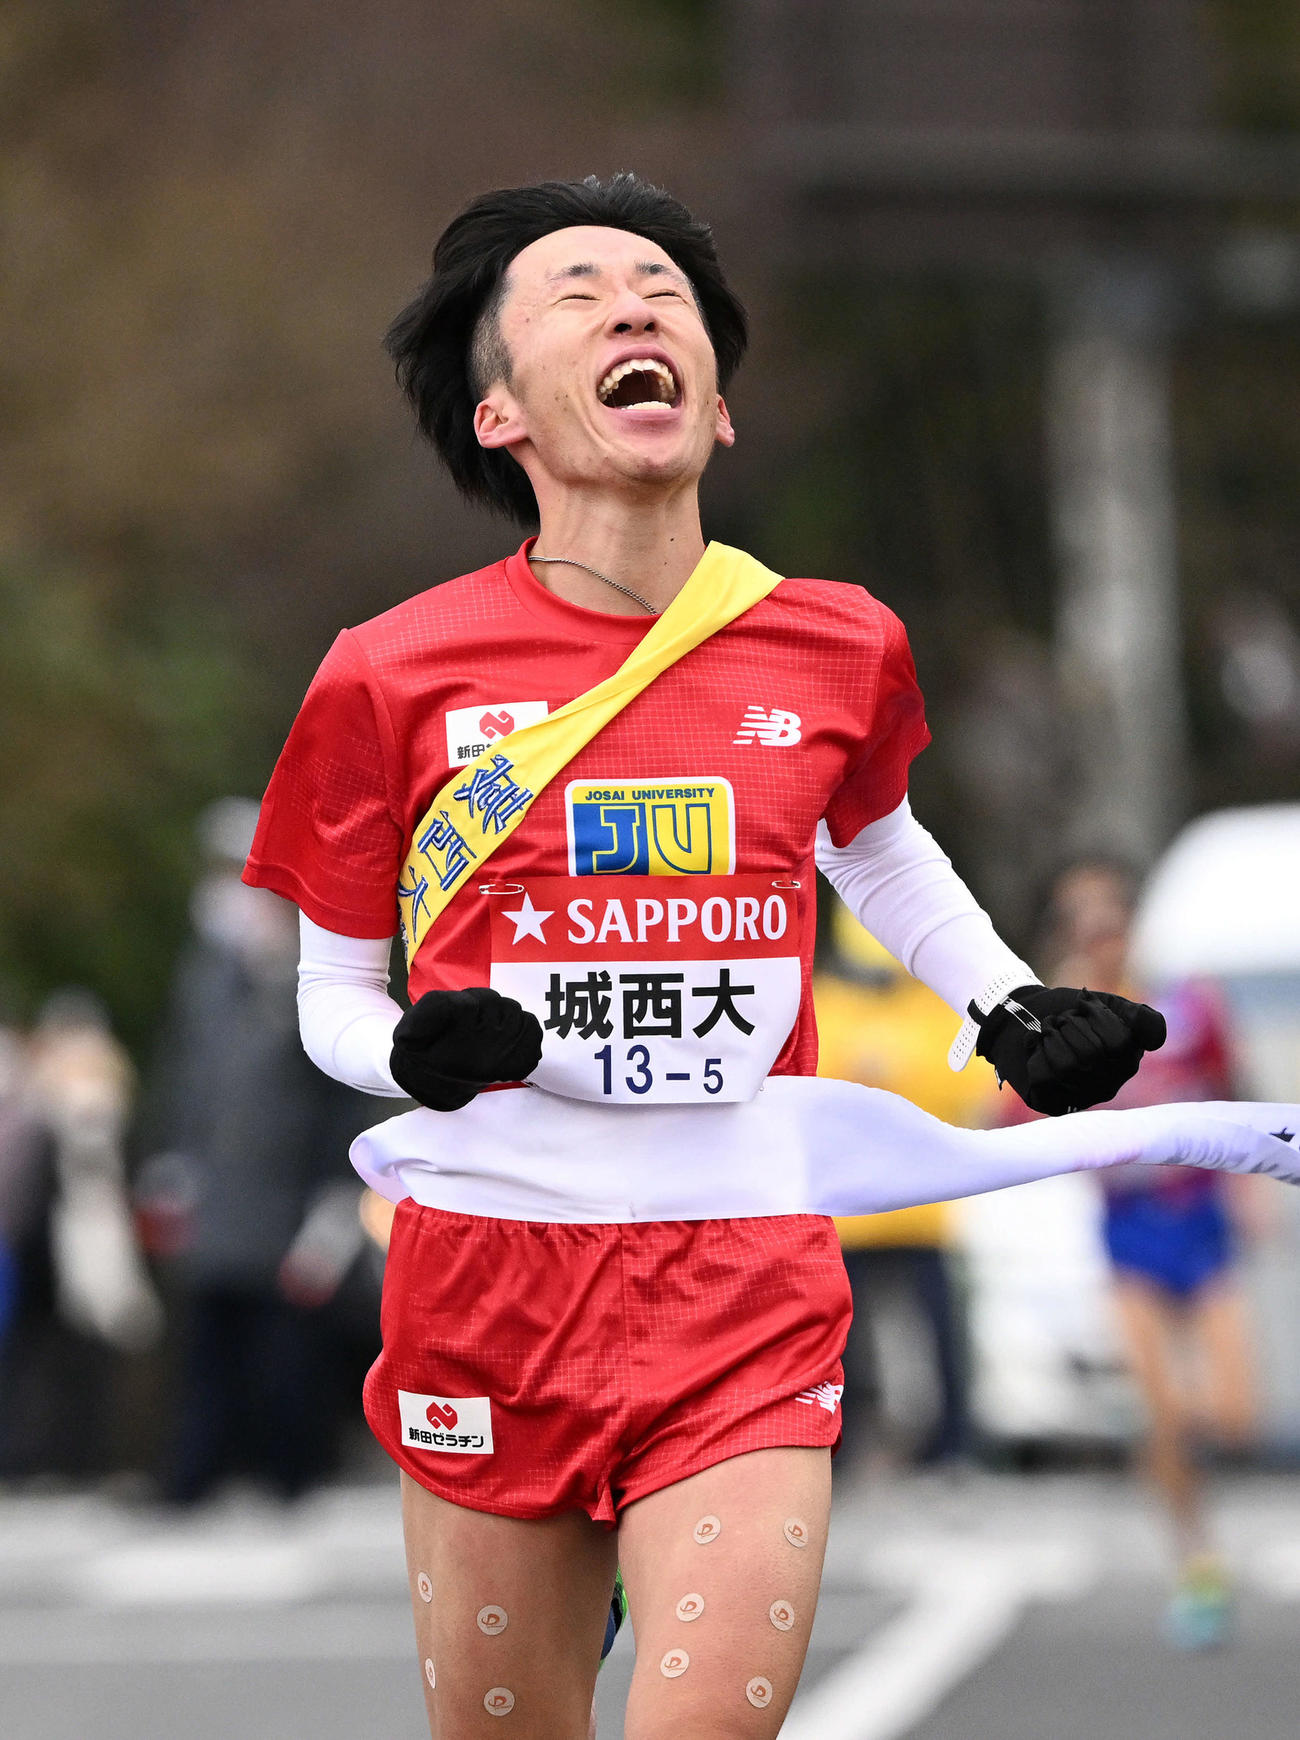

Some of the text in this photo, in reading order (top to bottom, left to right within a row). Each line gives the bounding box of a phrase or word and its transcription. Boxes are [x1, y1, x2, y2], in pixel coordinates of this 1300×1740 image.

[457, 743, 492, 759] 新田
[585, 787, 715, 801] JOSAI UNIVERSITY
[592, 803, 712, 875] JU
[567, 894, 787, 945] SAPPORO
[544, 968, 756, 1041] 城西大
[409, 1427, 484, 1448] 新田ゼラチン
